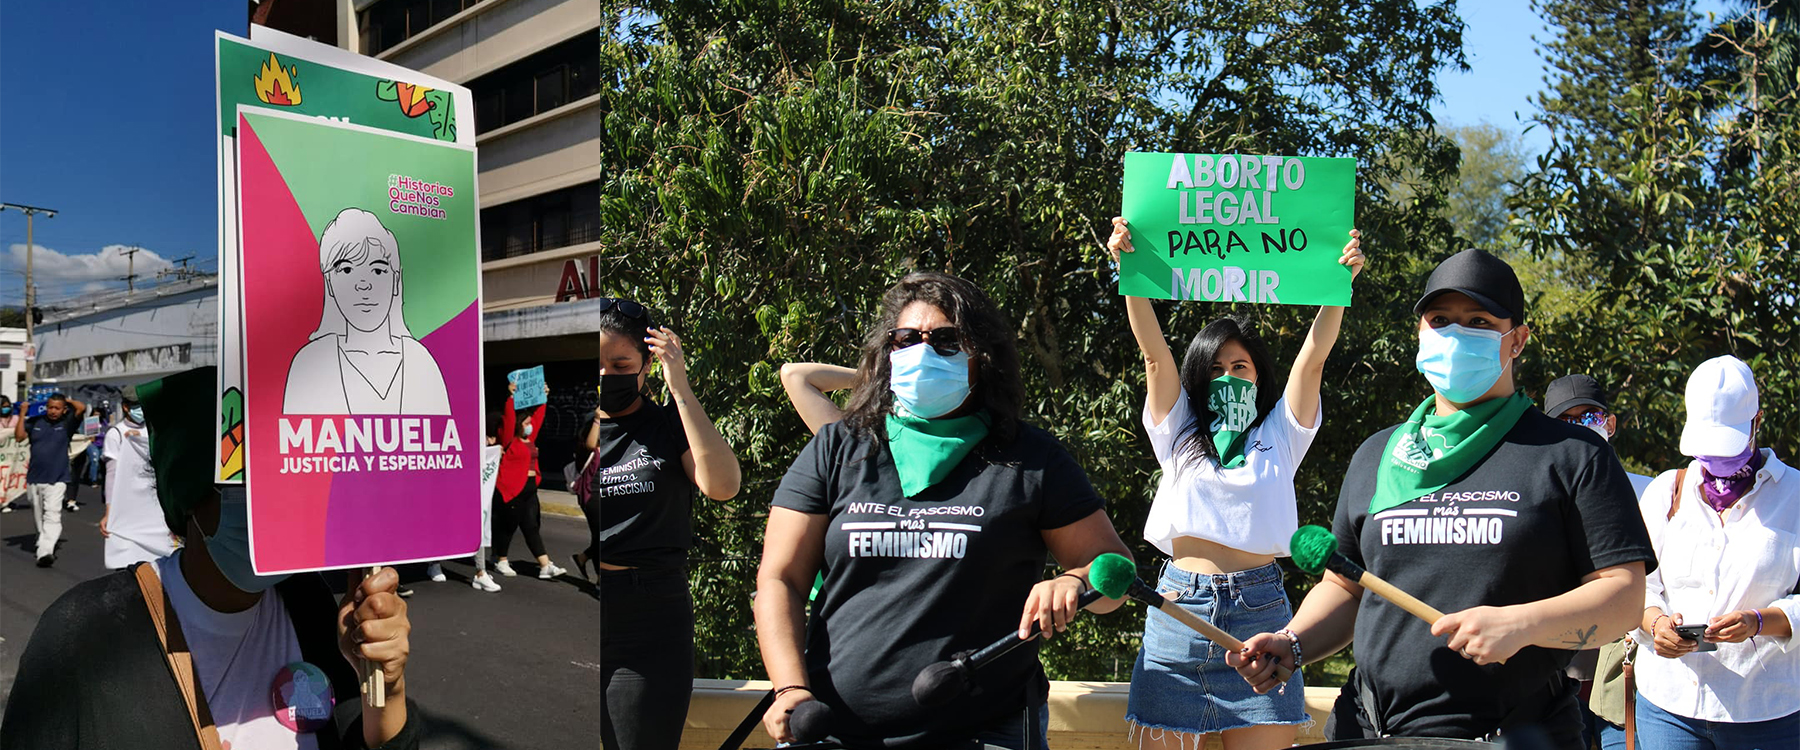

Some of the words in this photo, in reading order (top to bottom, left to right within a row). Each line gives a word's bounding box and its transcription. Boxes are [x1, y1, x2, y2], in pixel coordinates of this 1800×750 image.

[1166, 153, 1305, 191] ABORTO
[388, 174, 454, 198] #Historias
[388, 186, 440, 208] QueNos
[389, 199, 447, 220] Cambian
[1179, 190, 1280, 226] LEGAL
[1168, 229, 1250, 260] PARA
[1261, 228, 1307, 254] NO
[1171, 266, 1280, 303] MORIR
[1218, 385, 1236, 403] VA
[278, 418, 463, 454] MANUELA
[280, 456, 360, 474] JUSTICIA
[364, 456, 375, 471] Y
[379, 454, 463, 471] ESPERANZA
[607, 481, 655, 497] FASCISMO
[1441, 490, 1520, 502] FASCISMO
[847, 502, 886, 514] ANTE
[887, 505, 905, 517] EL
[908, 506, 985, 517] FASCISMO
[1433, 501, 1459, 516] más
[900, 512, 926, 530] más
[1381, 517, 1503, 546] FEMINISMO
[848, 531, 968, 559] FEMINISMO
